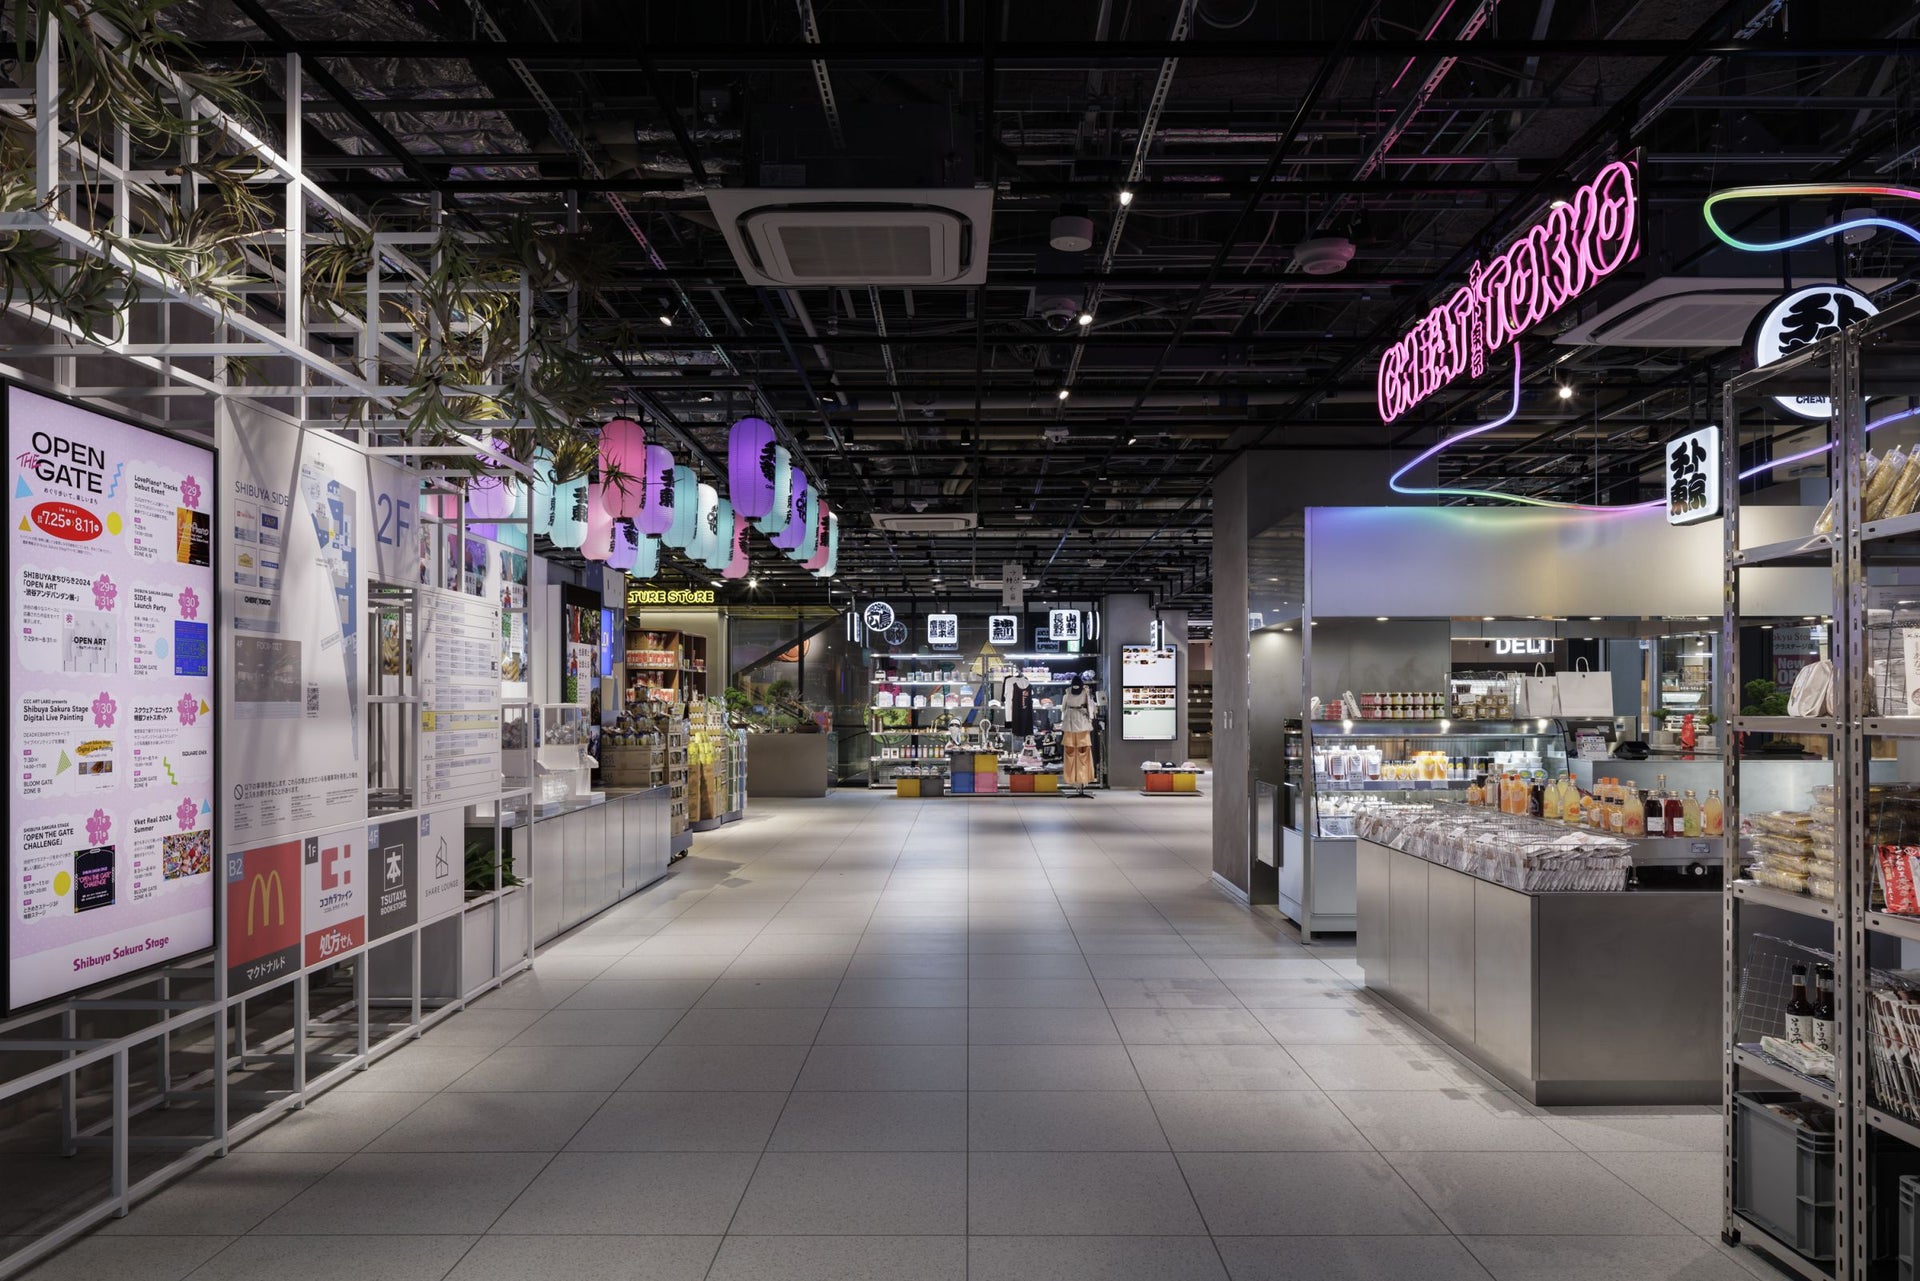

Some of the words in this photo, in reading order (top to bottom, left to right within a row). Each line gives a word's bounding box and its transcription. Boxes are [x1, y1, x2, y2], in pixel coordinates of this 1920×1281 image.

[1478, 161, 1635, 350] TOKYO
[32, 431, 105, 470] OPEN
[16, 452, 41, 469] THE
[35, 459, 103, 494] GATE
[134, 482, 150, 492] Debut
[151, 487, 165, 495] Event
[163, 482, 178, 492] Tracks
[235, 480, 271, 501] SHIBUYA
[272, 491, 289, 507] SIDE
[377, 493, 410, 547] 2F
[45, 582, 57, 590] ART
[667, 590, 714, 603] STORE
[134, 602, 152, 611] Launch
[153, 604, 166, 613] Party
[74, 637, 92, 645] OPEN
[1496, 639, 1546, 655] DELI
[24, 705, 48, 713] Shibuya
[72, 705, 89, 713] Stage
[24, 714, 44, 722] Digital
[60, 714, 84, 722] Painting
[58, 828, 74, 836] GATE
[134, 825, 154, 833] Summer
[307, 844, 317, 858] 1F
[228, 859, 243, 877] B2
[425, 885, 441, 898] SHARE
[441, 879, 459, 893] LOUNGE
[319, 890, 353, 908] ココカラファイン
[381, 889, 407, 906] TSUTAYA
[380, 900, 407, 916] BOOKSTORE
[319, 929, 353, 958] 処方せん
[73, 954, 111, 971] Shibuya
[113, 946, 143, 960] Sakura
[145, 937, 169, 950] Stage
[246, 956, 286, 980] マクドナルド
